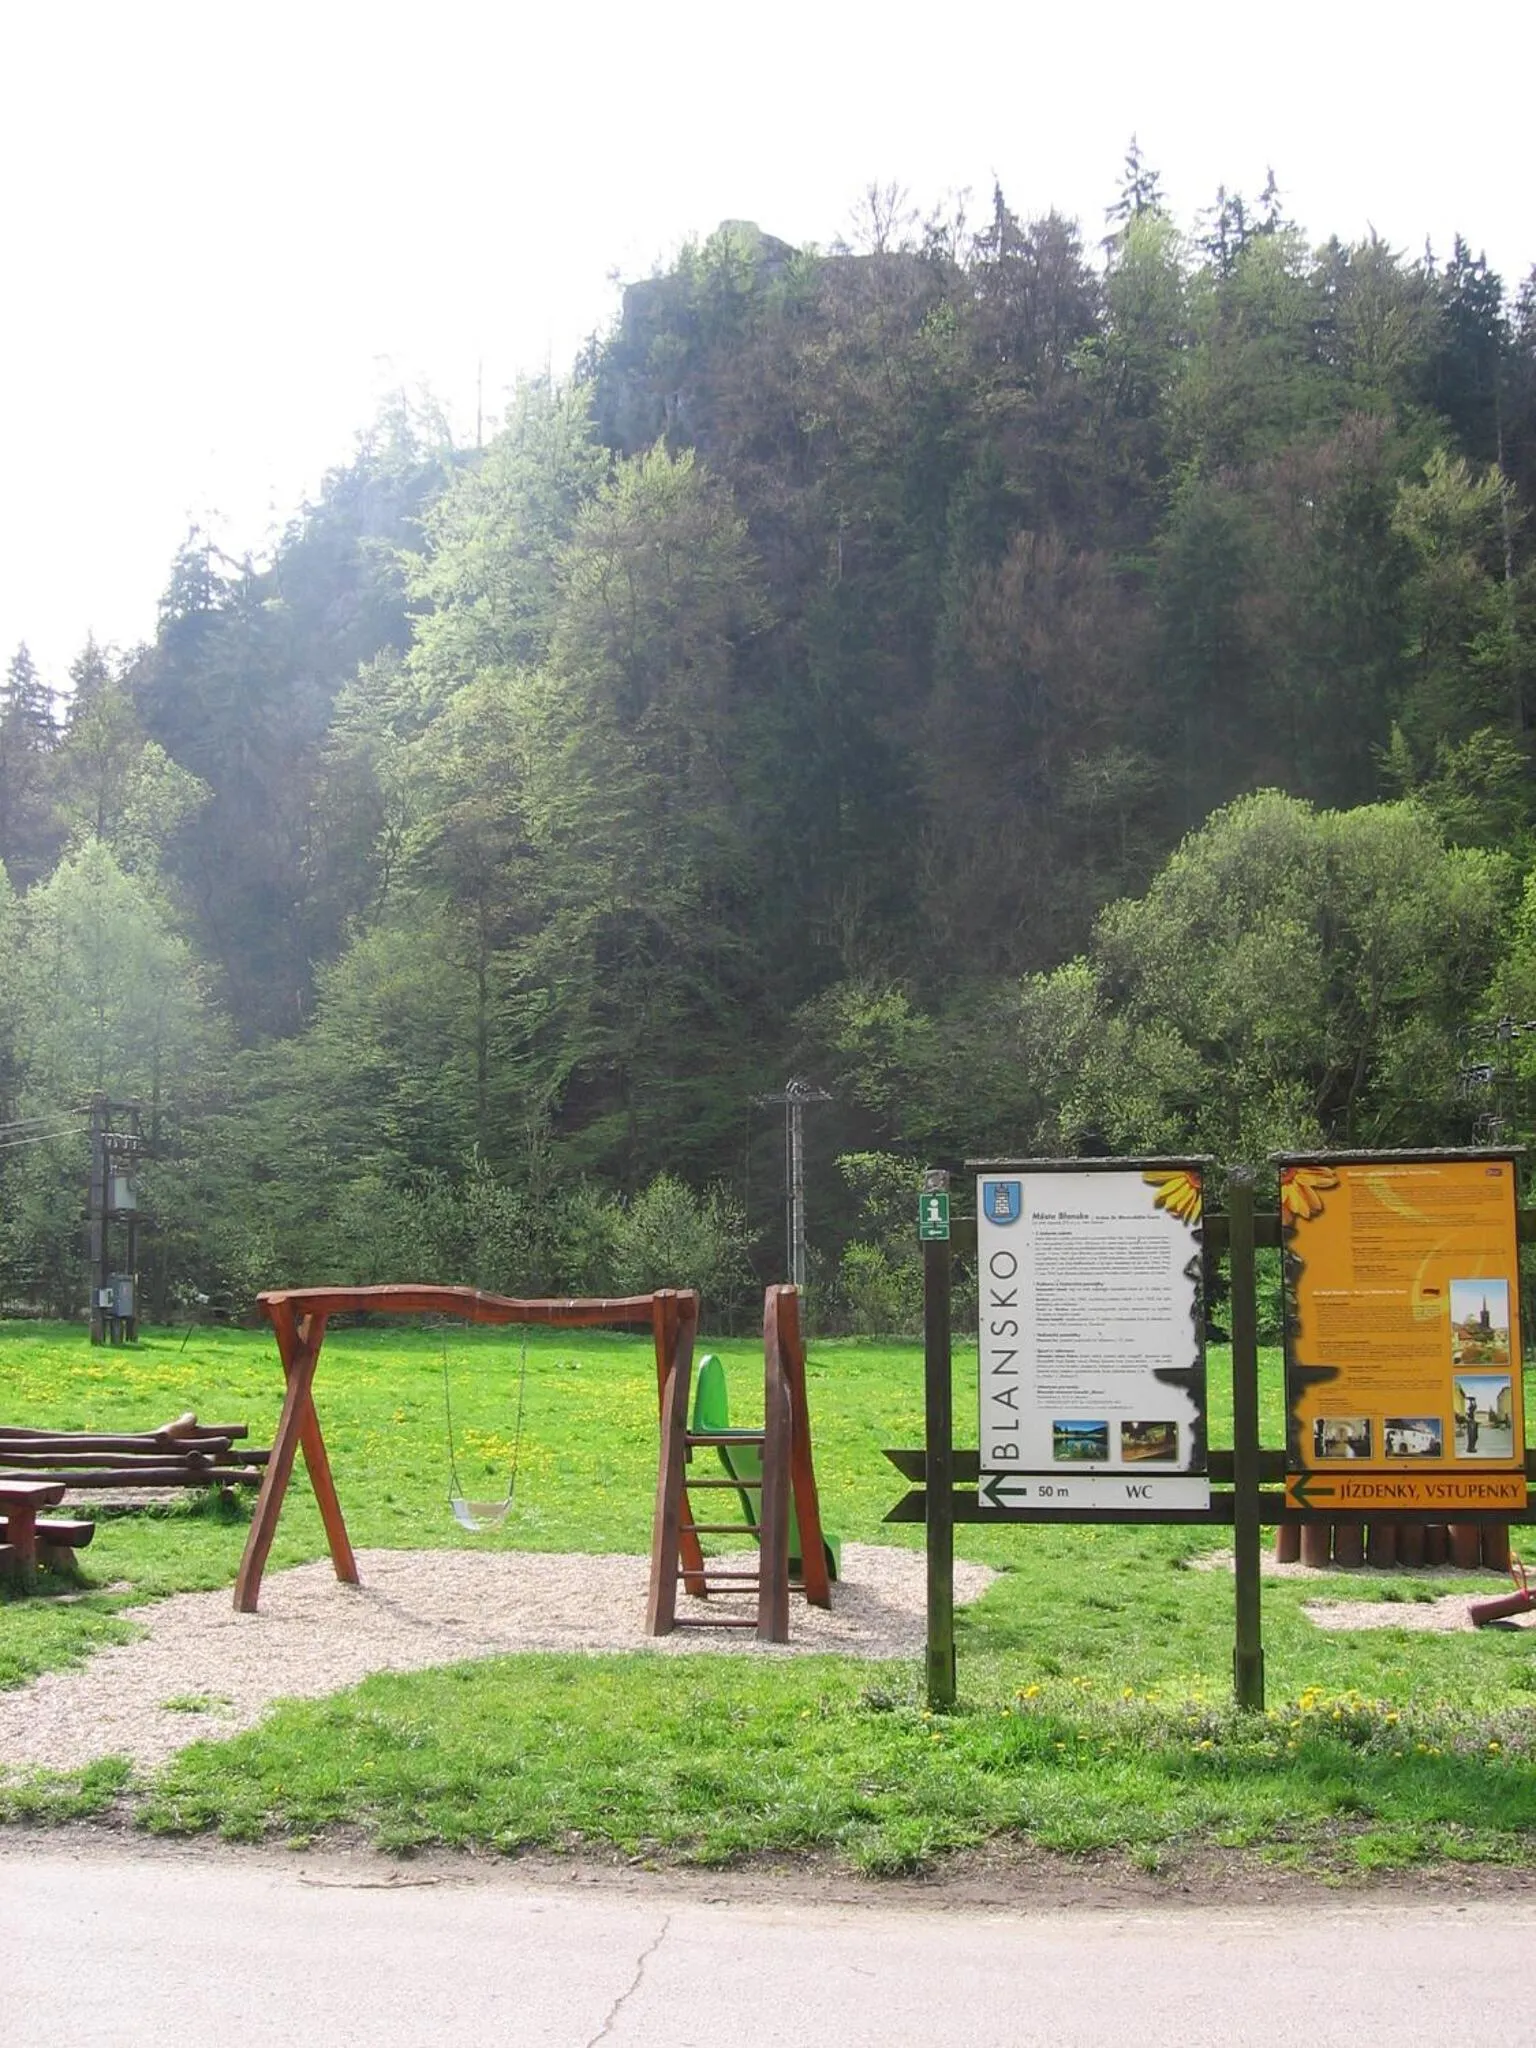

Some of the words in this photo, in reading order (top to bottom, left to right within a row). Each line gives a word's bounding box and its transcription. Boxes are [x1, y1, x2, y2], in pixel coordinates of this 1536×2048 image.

[989, 1250, 1020, 1460] BLANSKO
[1038, 1485, 1054, 1498] 50
[1057, 1487, 1069, 1497] m
[1125, 1485, 1153, 1499] WC
[1340, 1480, 1421, 1501] JÍZDENKY,
[1425, 1483, 1520, 1499] VSTUPENKY
